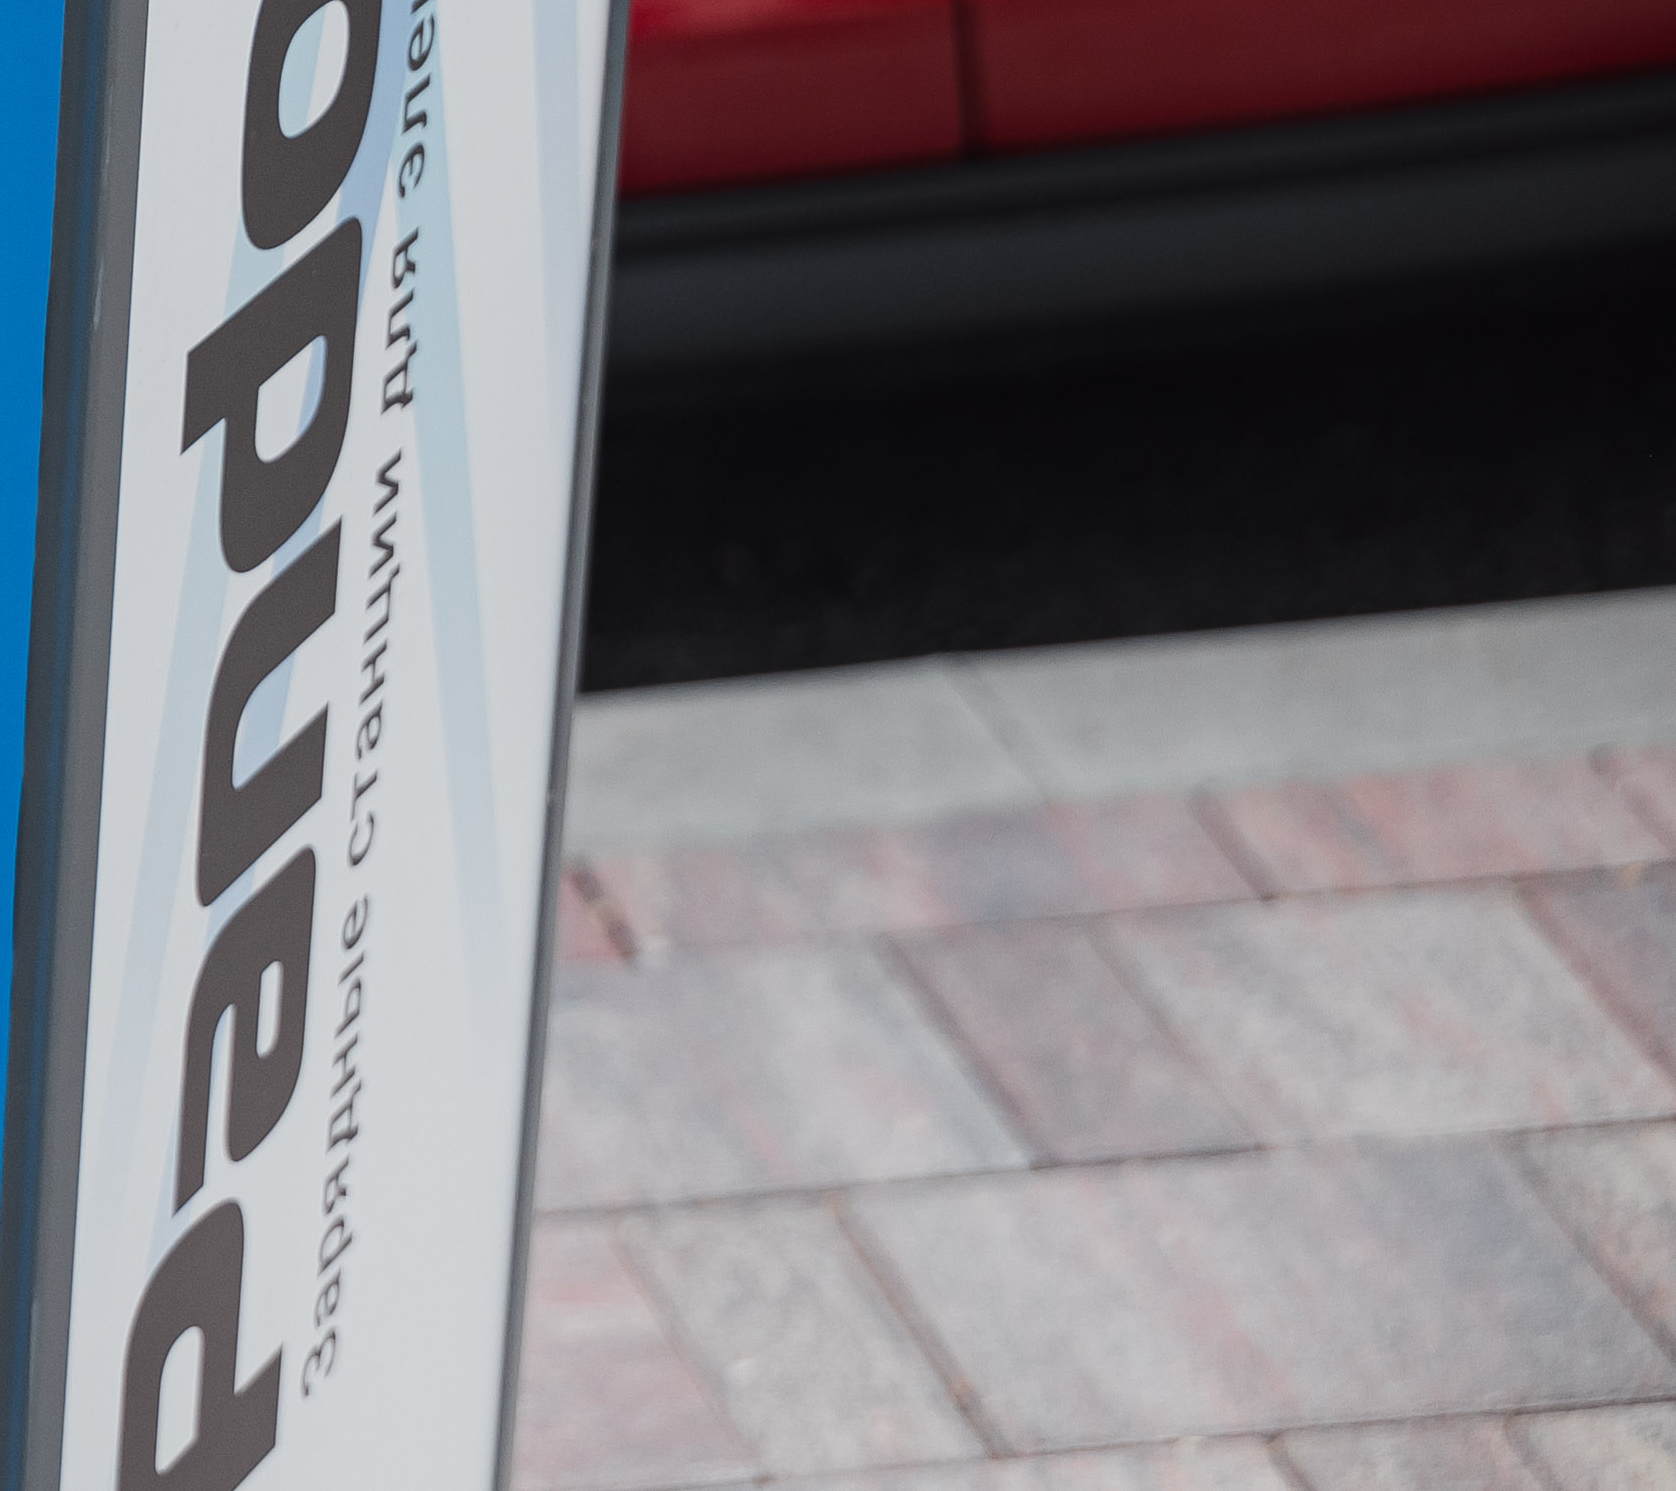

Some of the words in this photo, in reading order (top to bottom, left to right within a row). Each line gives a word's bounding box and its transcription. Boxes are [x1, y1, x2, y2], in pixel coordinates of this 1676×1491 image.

[303, 892, 369, 1398] Зарядные
[346, 446, 403, 868] станции
[380, 225, 420, 415] для
